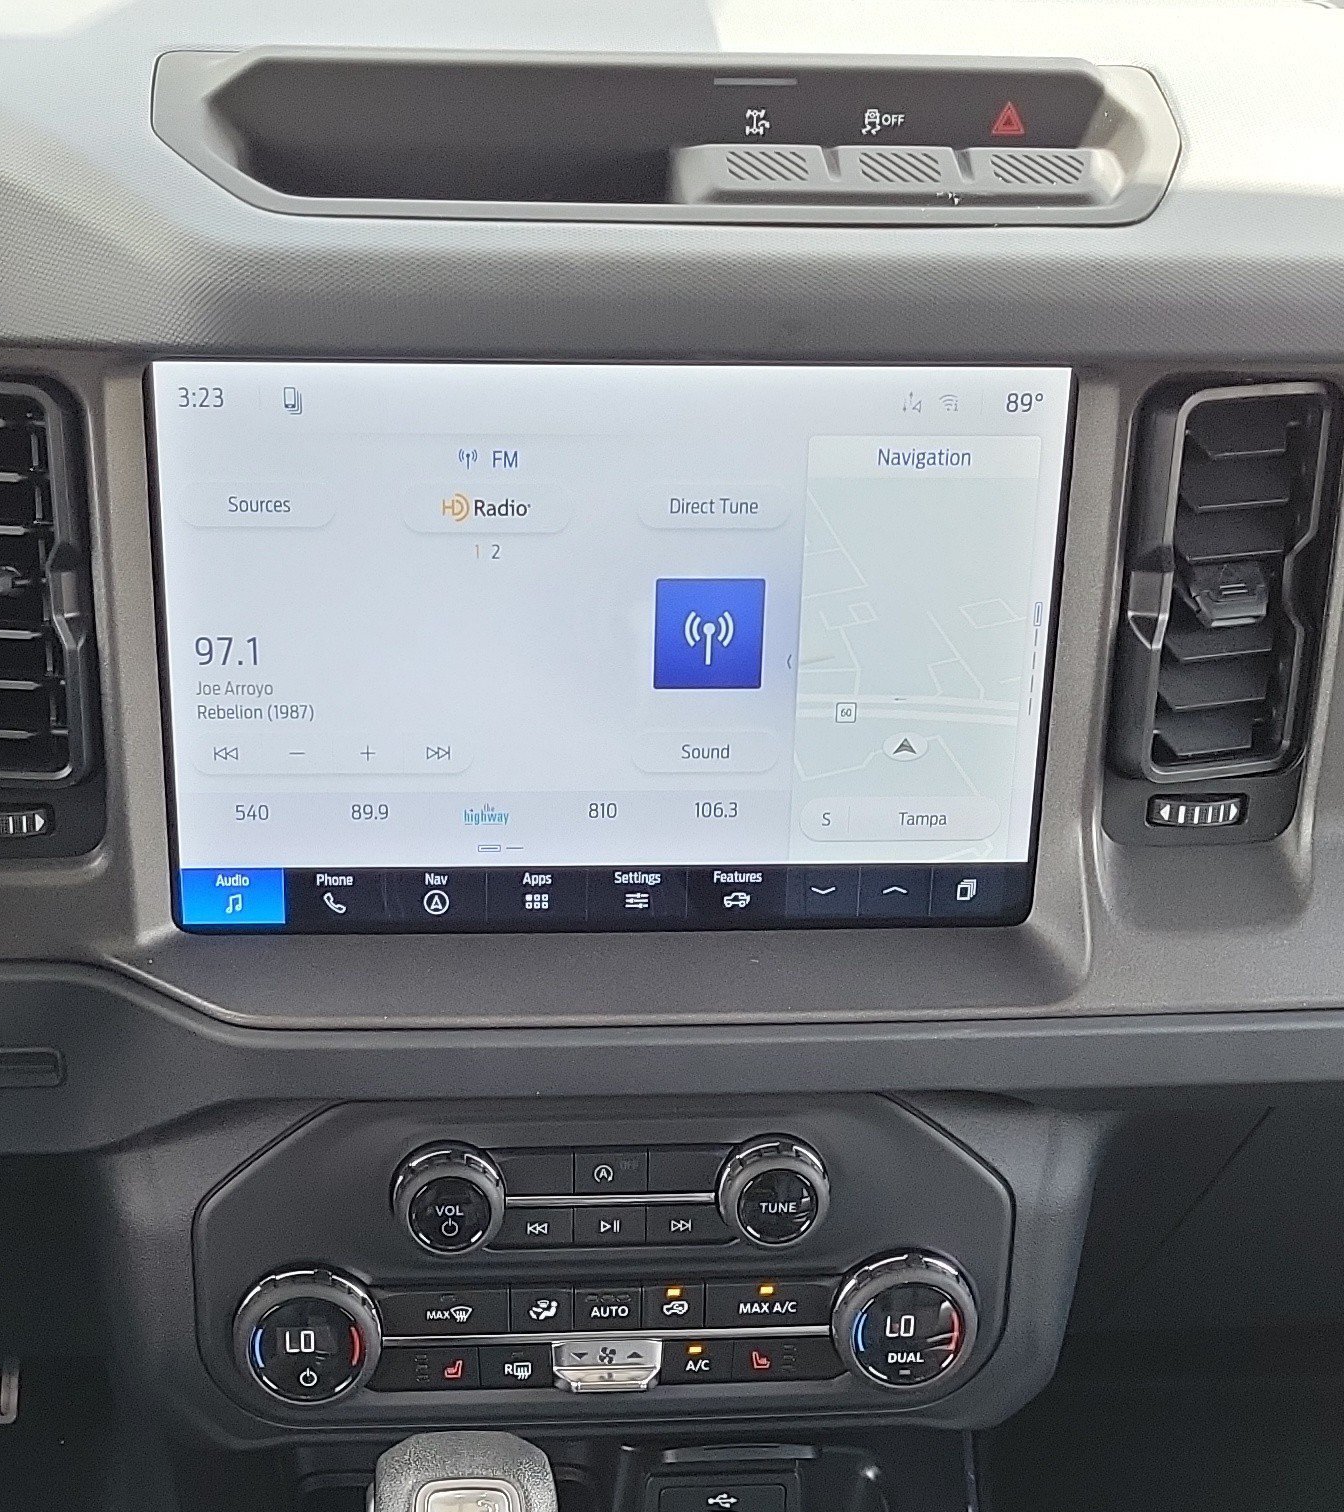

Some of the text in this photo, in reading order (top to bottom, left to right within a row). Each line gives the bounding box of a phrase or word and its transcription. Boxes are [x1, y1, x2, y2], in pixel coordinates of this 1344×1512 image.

[882, 113, 905, 128] OFF
[178, 386, 224, 409] 3:23
[1006, 392, 1044, 413] 89°
[492, 450, 519, 469] FM
[877, 447, 972, 469] Navigation
[228, 495, 292, 514] Sources
[669, 497, 759, 515] Direct Tune
[491, 544, 501, 560] 2
[195, 636, 258, 666] 97.1
[196, 680, 274, 698] Joe Arroyo
[197, 704, 314, 721] Rebelion (1987)
[681, 743, 730, 760] Sound
[235, 804, 269, 821] 540
[351, 803, 389, 820] 89.9
[463, 809, 510, 825] highway
[588, 802, 617, 819] 810
[694, 801, 738, 818] 106.3
[821, 811, 831, 827] S
[898, 811, 947, 828] Tampa
[216, 873, 250, 887] Audio
[316, 873, 354, 887] Phone
[425, 873, 448, 886] Nav
[523, 872, 552, 887] Apps
[614, 869, 662, 887] Settings
[713, 869, 763, 884] Features
[435, 1205, 464, 1217] VOL
[759, 1201, 797, 1214] TUNE
[426, 1309, 450, 1321] MAX
[590, 1305, 629, 1318] AUTO
[739, 1300, 797, 1315] MAX A/C
[885, 1314, 915, 1338] LO
[285, 1330, 315, 1353] LO
[685, 1359, 710, 1373] A/C
[887, 1351, 924, 1364] DUAL
